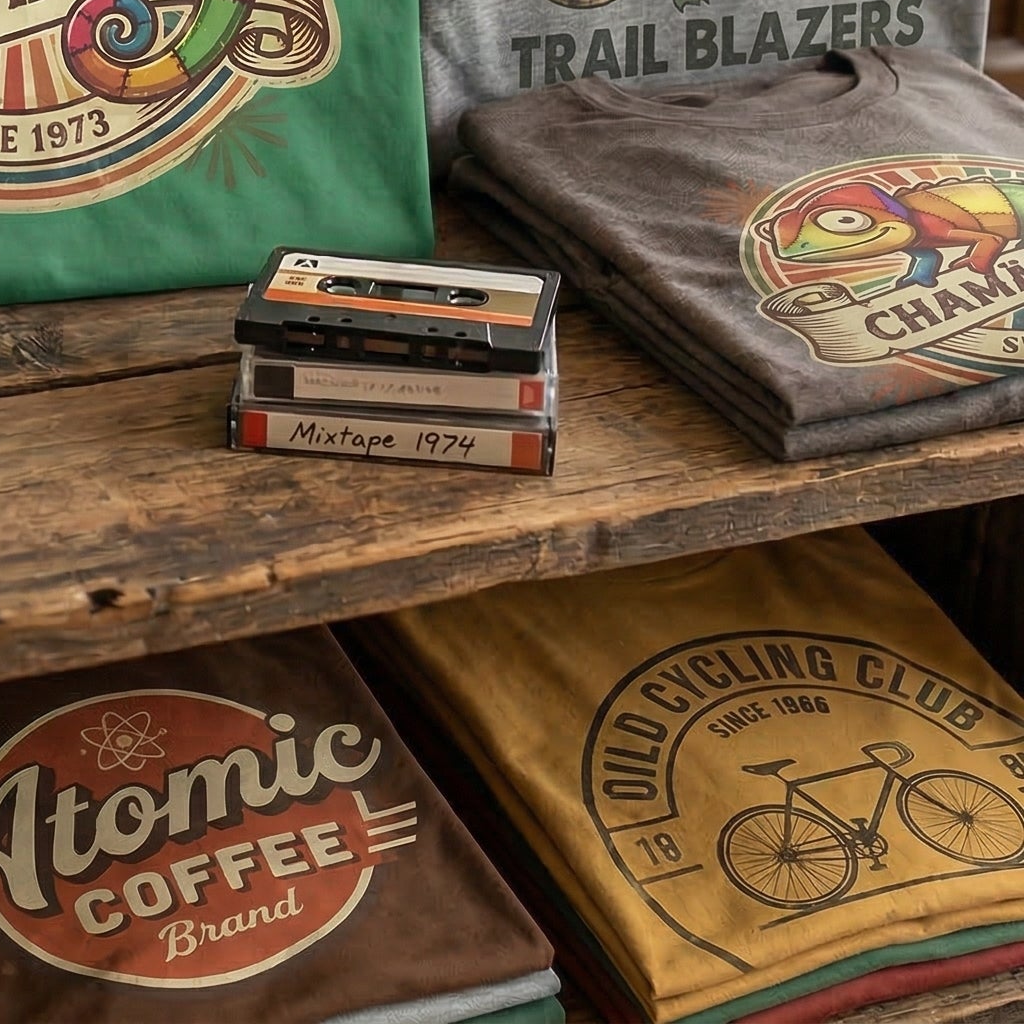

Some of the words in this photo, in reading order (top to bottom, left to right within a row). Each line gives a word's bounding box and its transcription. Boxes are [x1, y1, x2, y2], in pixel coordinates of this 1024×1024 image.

[511, 24, 668, 89] TRAIL
[32, 109, 110, 153] 1973
[1002, 336, 1024, 353] S
[289, 421, 396, 456] Mixtape
[416, 431, 475, 457] 1974
[640, 644, 838, 714] CYCLING
[855, 654, 984, 732] CLUB
[707, 702, 771, 739] SINCE
[772, 695, 831, 714] 1966
[636, 832, 682, 865] 18
[75, 821, 353, 935] COFFEE
[158, 887, 304, 962] Brand
